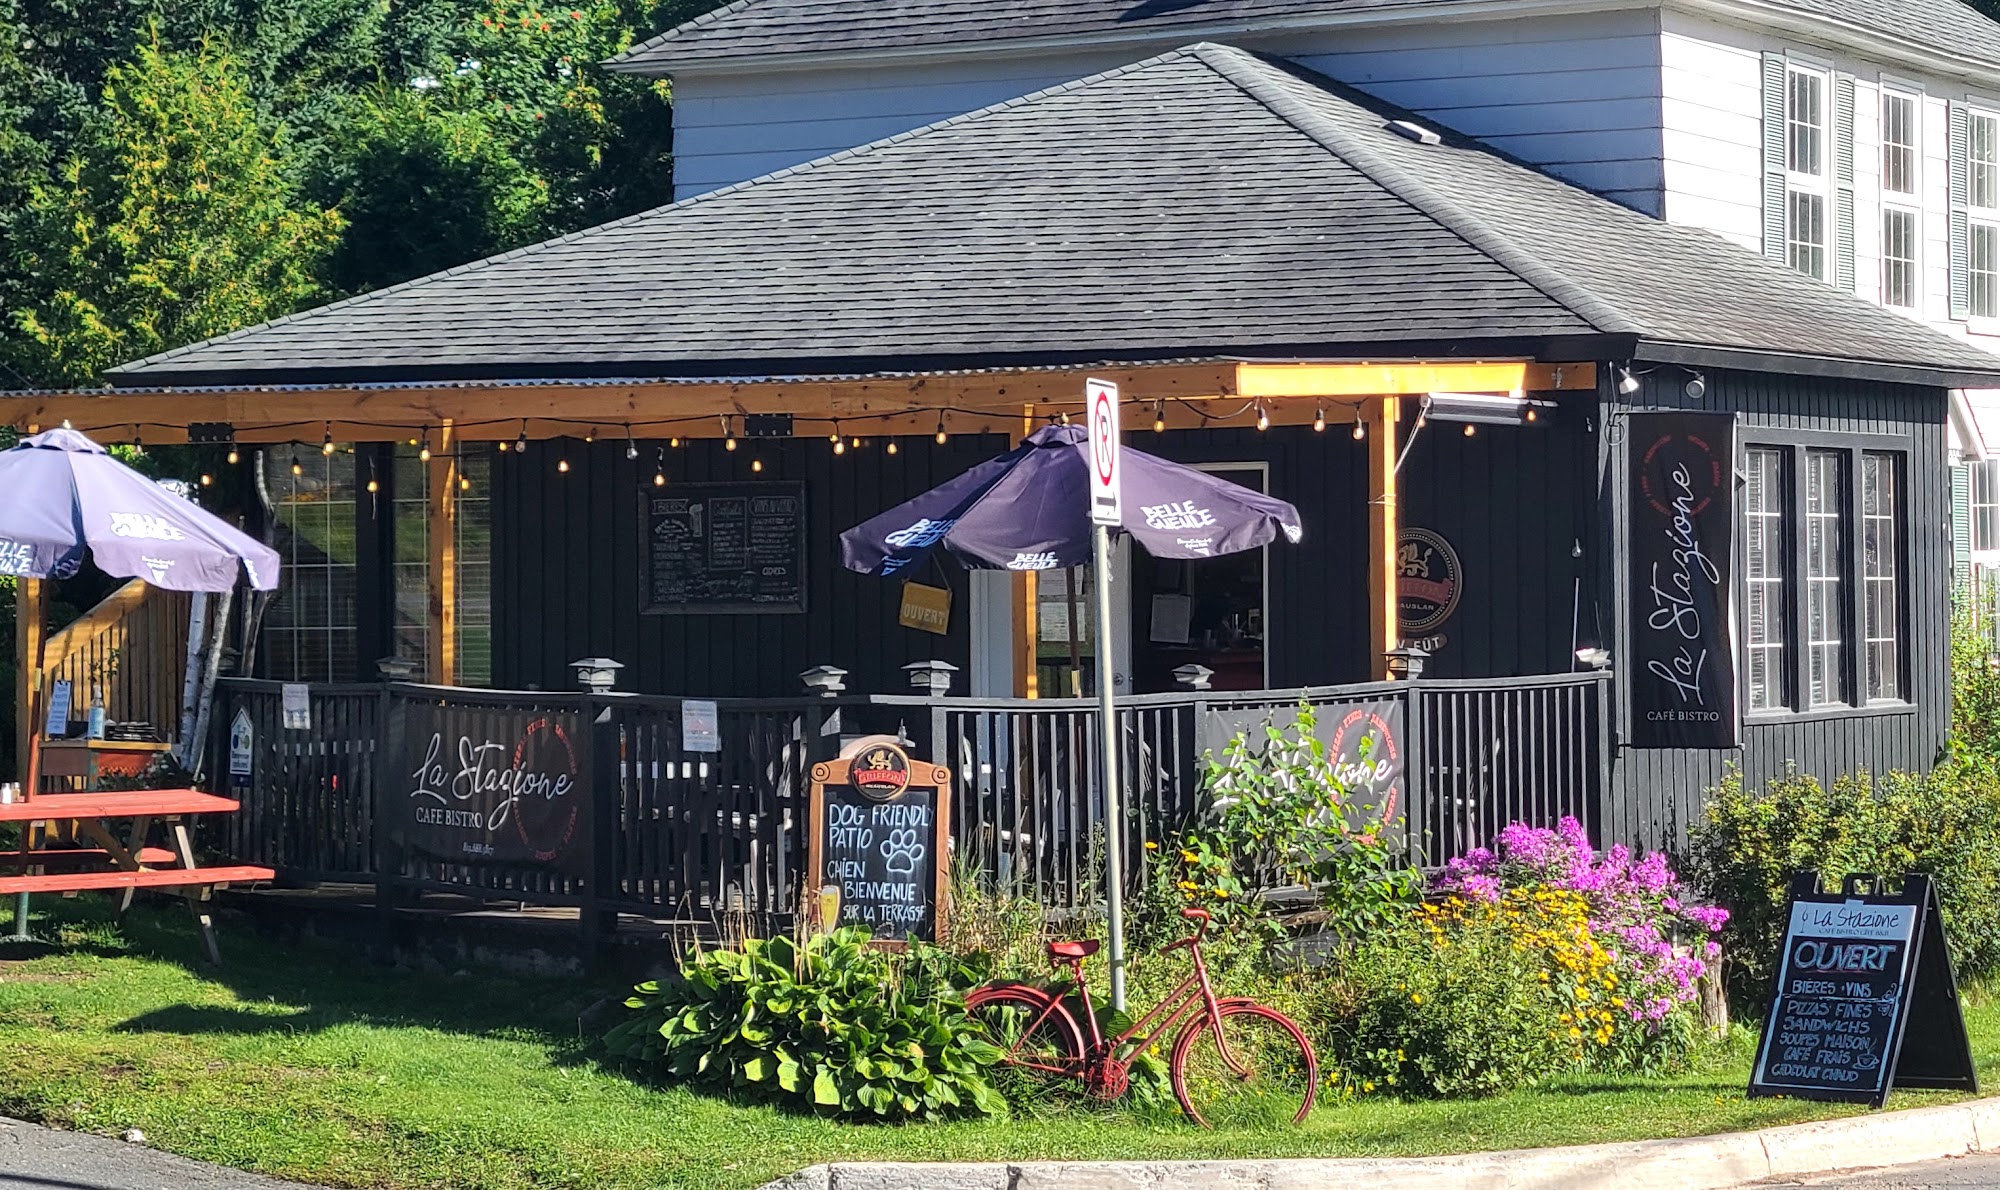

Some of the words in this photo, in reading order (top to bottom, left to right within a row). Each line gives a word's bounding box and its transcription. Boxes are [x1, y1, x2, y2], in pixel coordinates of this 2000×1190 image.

[1140, 500, 1198, 518] BELLE
[1146, 508, 1216, 530] GUEULE
[1014, 551, 1056, 562] BELLE
[1648, 461, 1720, 640] Stazione
[1006, 559, 1059, 570] GUEULE
[904, 603, 945, 625] OUVERT
[1400, 603, 1434, 611] AUSLAN
[1647, 646, 1706, 706] La
[1647, 708, 1676, 721] CAFÉ
[1678, 711, 1719, 722] BISTRO
[410, 732, 449, 805] La
[452, 735, 573, 831] Stazione
[859, 772, 901, 783] GRIFFON
[416, 806, 443, 826] CAFE
[445, 811, 483, 828] BISTRO
[829, 803, 865, 827] DOG
[829, 827, 873, 850] PATIO
[827, 857, 866, 879] CHIEN
[844, 881, 917, 901] BIENVENUE
[843, 904, 860, 921] SUR
[863, 905, 876, 922] LA
[878, 904, 927, 922] TERRASSE
[1813, 909, 1833, 927] La
[1837, 907, 1899, 928] Stazione
[1794, 941, 1897, 971] OUVERT
[1845, 981, 1872, 998] VINS
[1786, 1000, 1830, 1016] PIZZAS
[1835, 1002, 1873, 1018] FINES
[1783, 1016, 1871, 1034] SANDWICHS
[1779, 1032, 1820, 1047] SOUPES
[1824, 1033, 1870, 1050] MAISON
[1815, 1049, 1851, 1065] FRAIS
[1821, 1068, 1860, 1082] CHAUD
